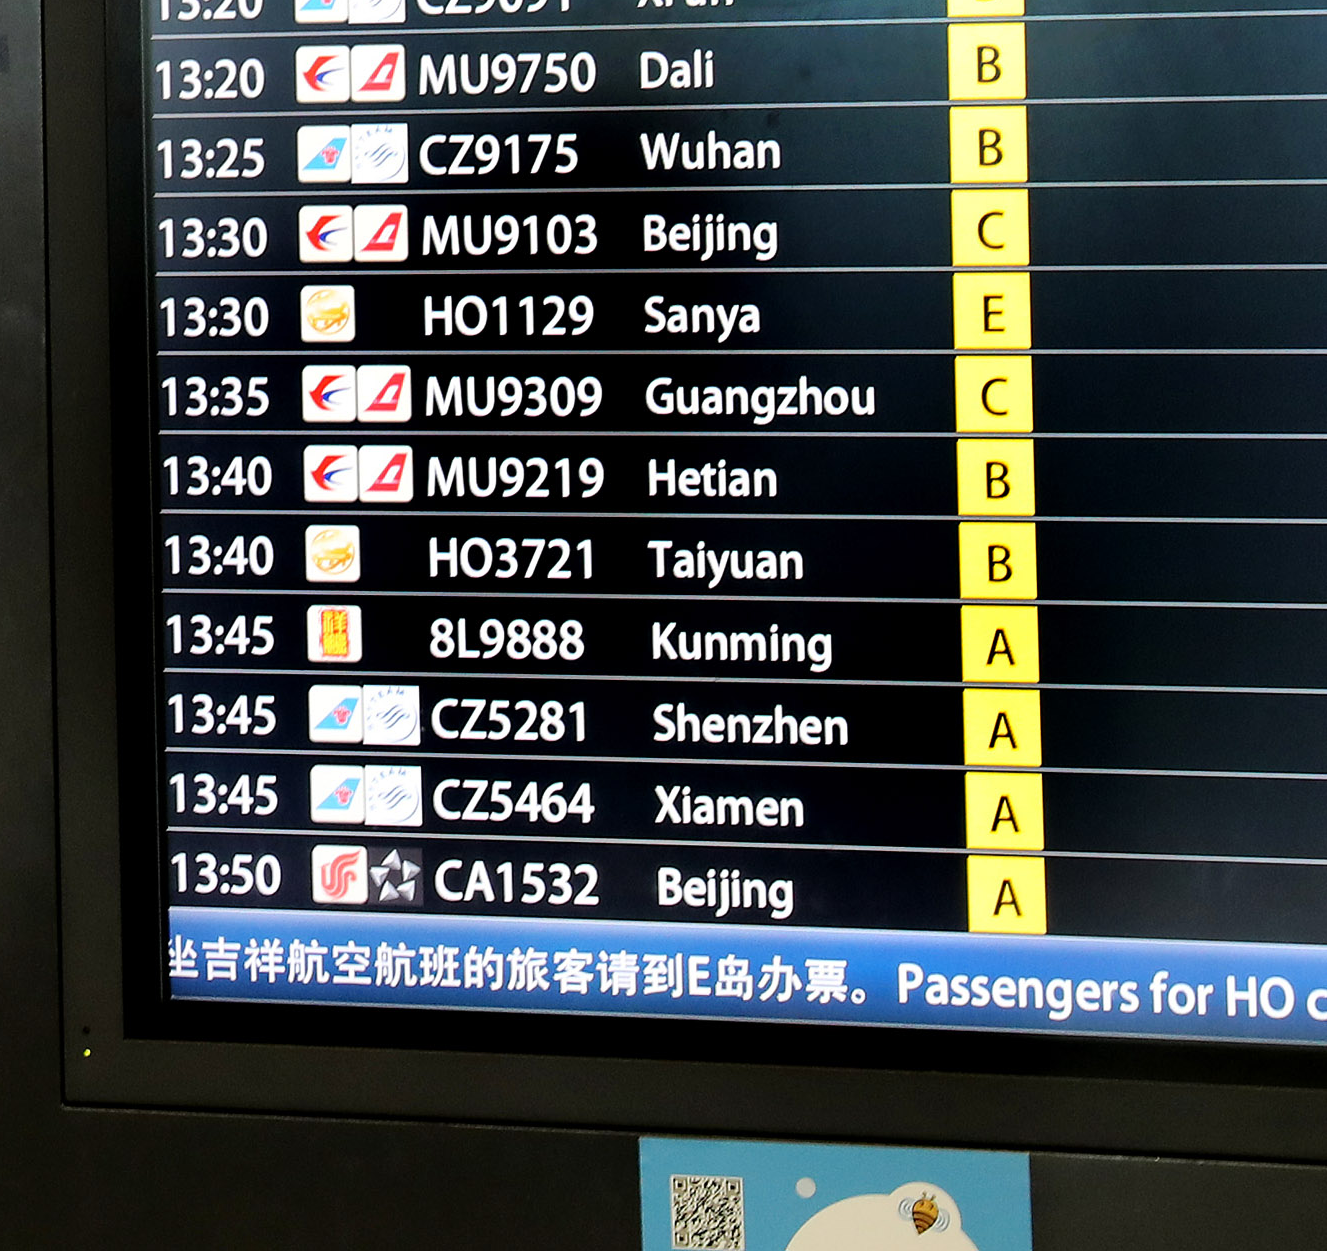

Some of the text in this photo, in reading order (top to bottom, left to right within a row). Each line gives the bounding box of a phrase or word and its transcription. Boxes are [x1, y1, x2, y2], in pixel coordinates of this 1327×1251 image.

[155, 45, 1002, 100] 13:20 MU9750 Dali B
[159, 294, 1005, 344] 13:30 HO1129 Sanya E
[166, 614, 275, 656] 13:45
[429, 617, 585, 661] 8L9888
[652, 621, 833, 673] Kunming
[986, 628, 1016, 666] A
[898, 962, 1140, 1021] Passengers
[1149, 970, 1214, 1016] for
[1226, 975, 1295, 1019] HO
